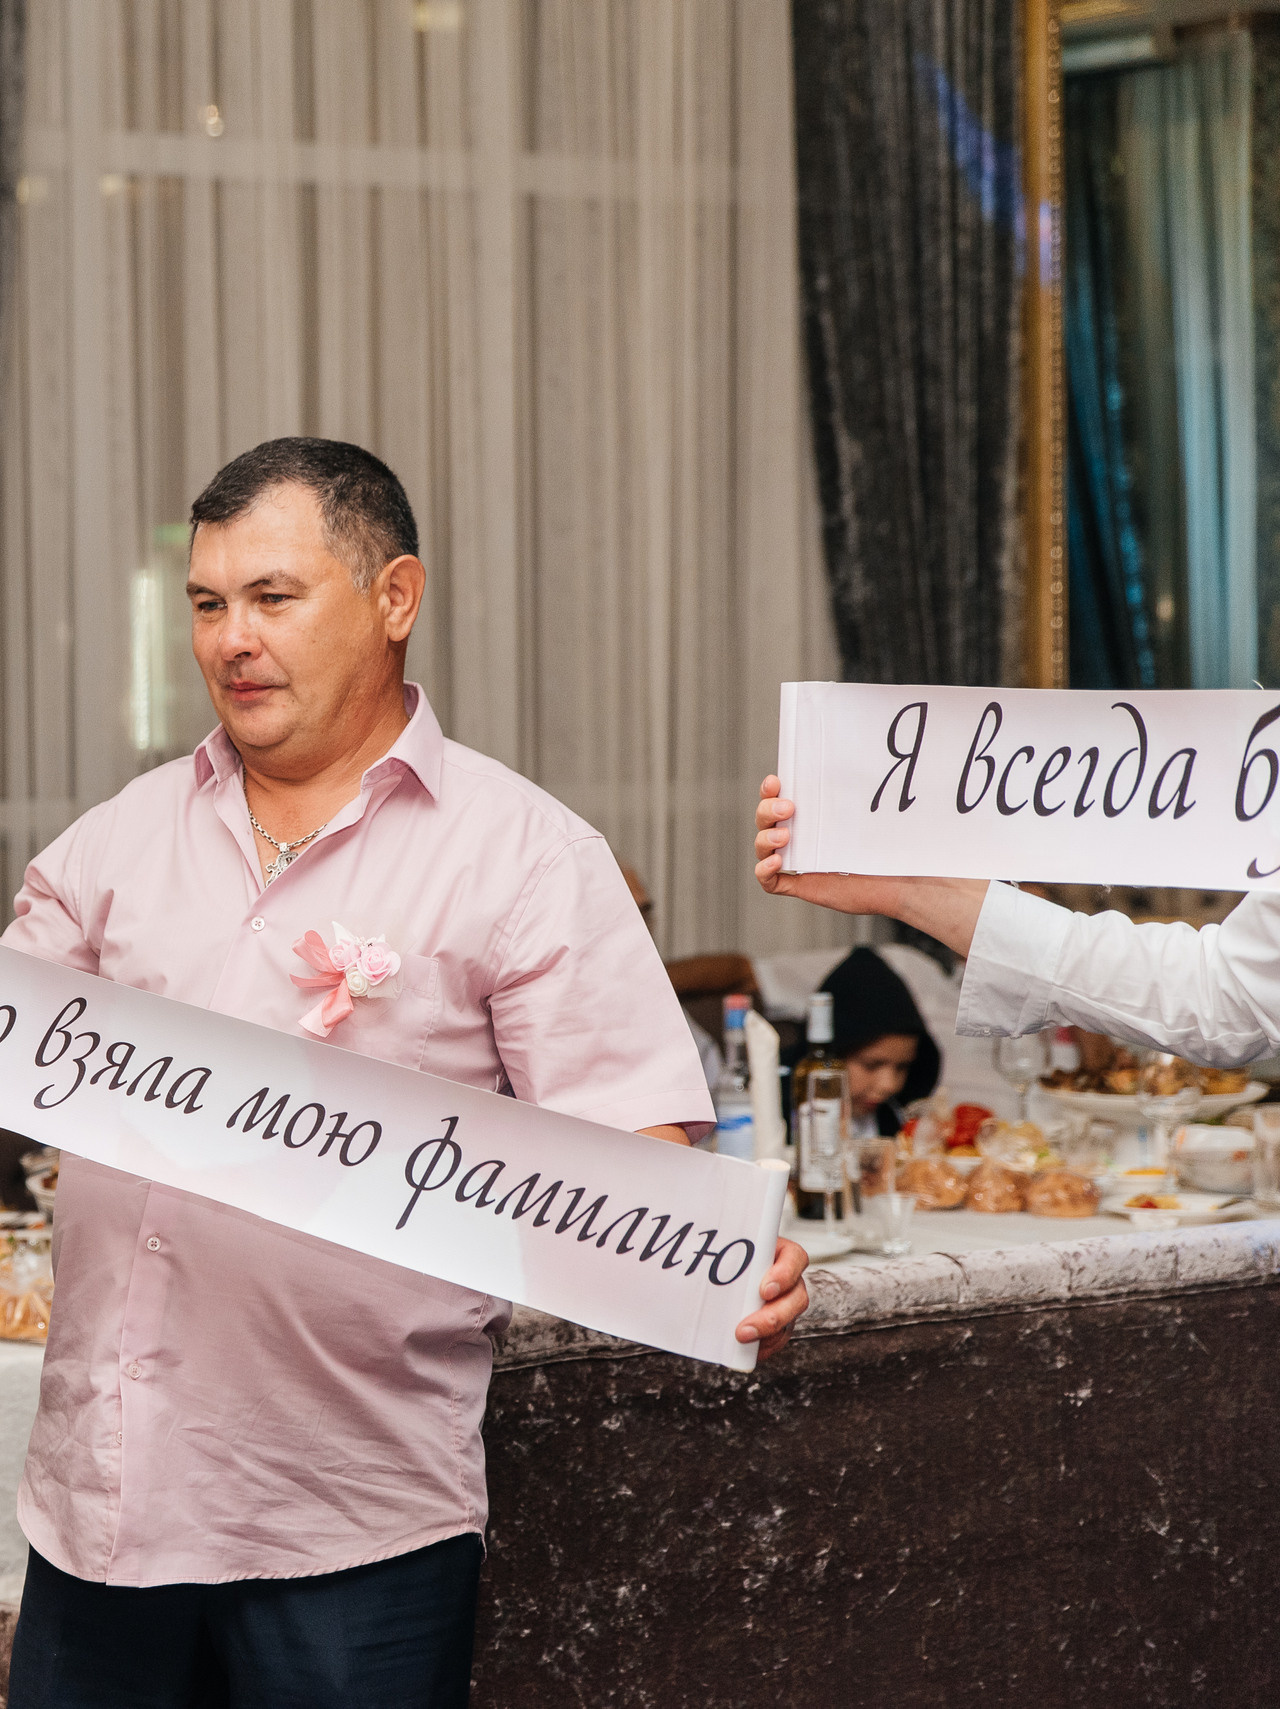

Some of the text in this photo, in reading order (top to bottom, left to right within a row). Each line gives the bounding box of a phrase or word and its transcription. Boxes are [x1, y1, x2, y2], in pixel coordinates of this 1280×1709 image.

[870, 701, 929, 813] Я
[956, 701, 1198, 820] всегда
[33, 996, 213, 1115] взяла
[226, 1086, 383, 1167] мою
[395, 1115, 756, 1286] фамилию
